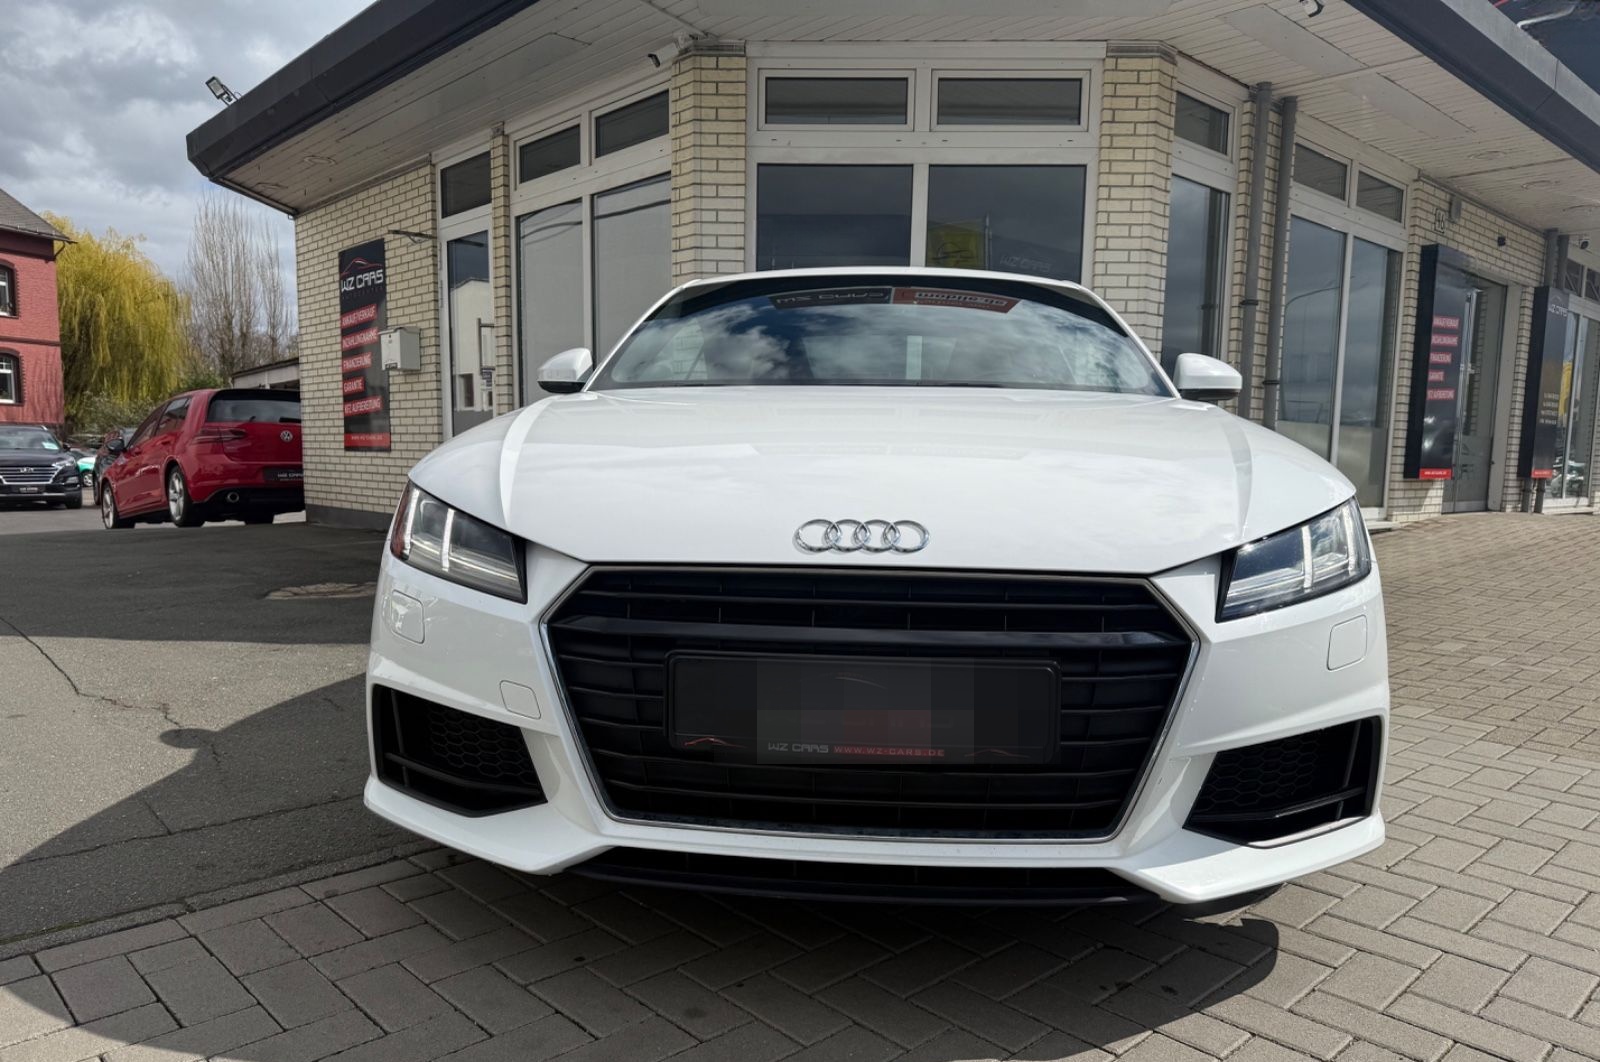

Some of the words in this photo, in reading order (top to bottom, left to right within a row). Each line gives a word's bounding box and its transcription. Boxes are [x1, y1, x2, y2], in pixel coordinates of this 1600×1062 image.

[341, 276, 355, 292] WZ
[356, 269, 384, 289] CARS
[767, 742, 789, 752] WZ
[791, 743, 829, 753] CARS
[833, 745, 945, 757] WWW.WZ-CARS.DE
